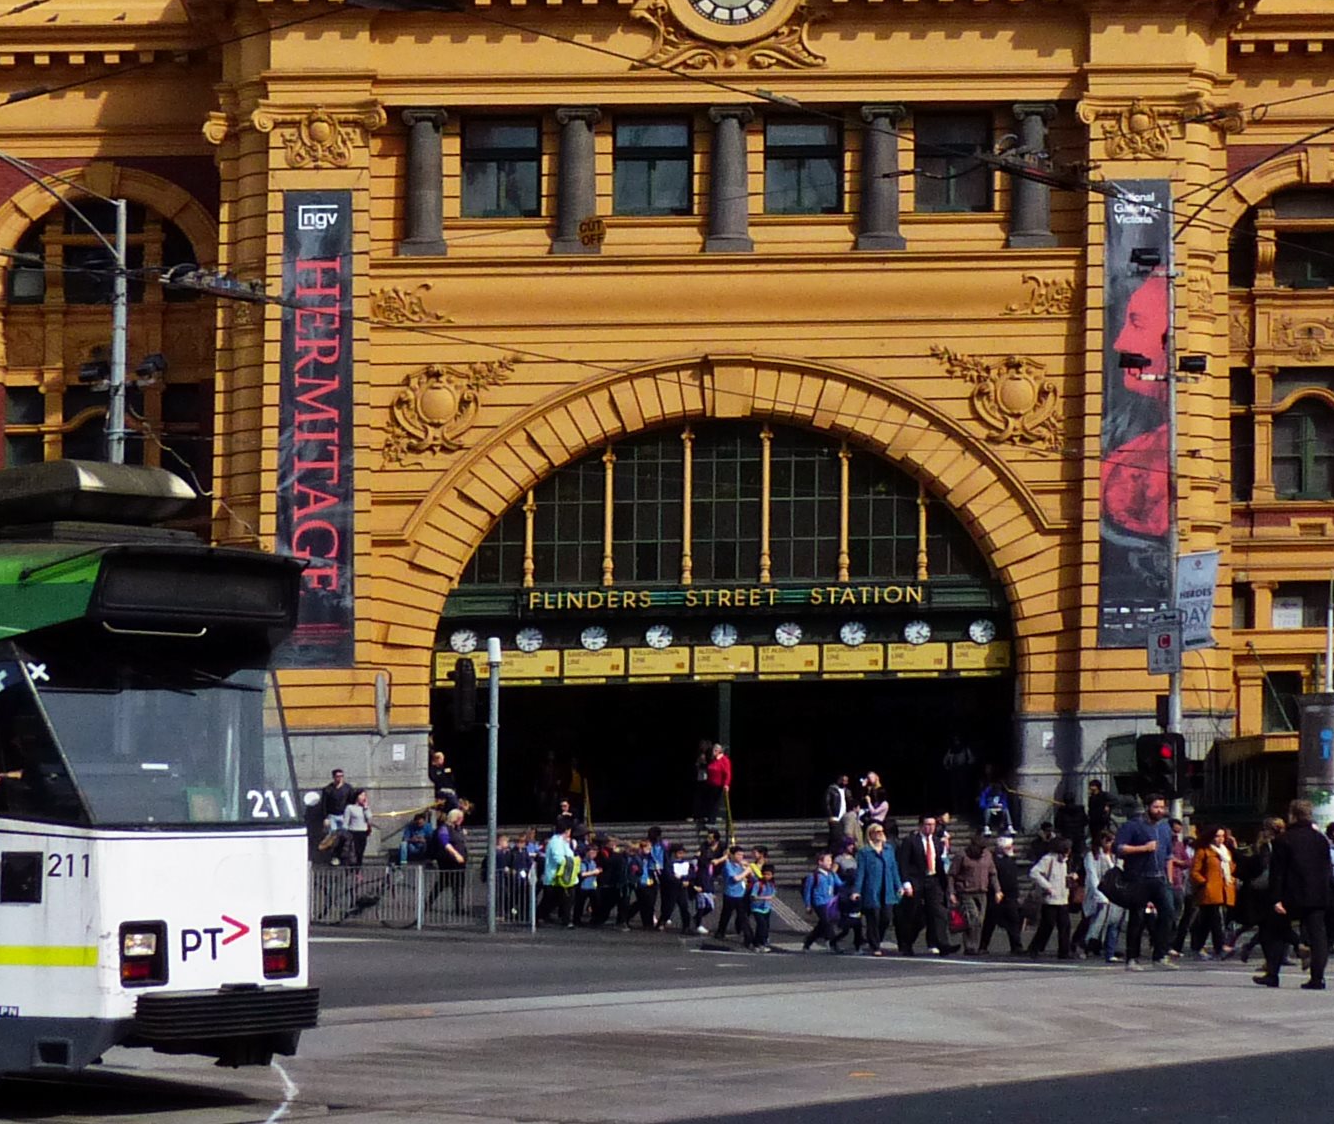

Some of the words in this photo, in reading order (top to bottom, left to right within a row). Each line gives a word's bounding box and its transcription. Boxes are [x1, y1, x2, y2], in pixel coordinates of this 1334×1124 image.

[303, 211, 338, 230] ngv
[580, 233, 605, 247] OFF
[292, 256, 342, 597] HERMITAGE
[528, 591, 652, 610] FLINDERS
[685, 588, 780, 608] STREET
[810, 585, 924, 605] STATION
[246, 789, 296, 818] 211
[46, 853, 91, 878] 211
[181, 927, 224, 962] PT
